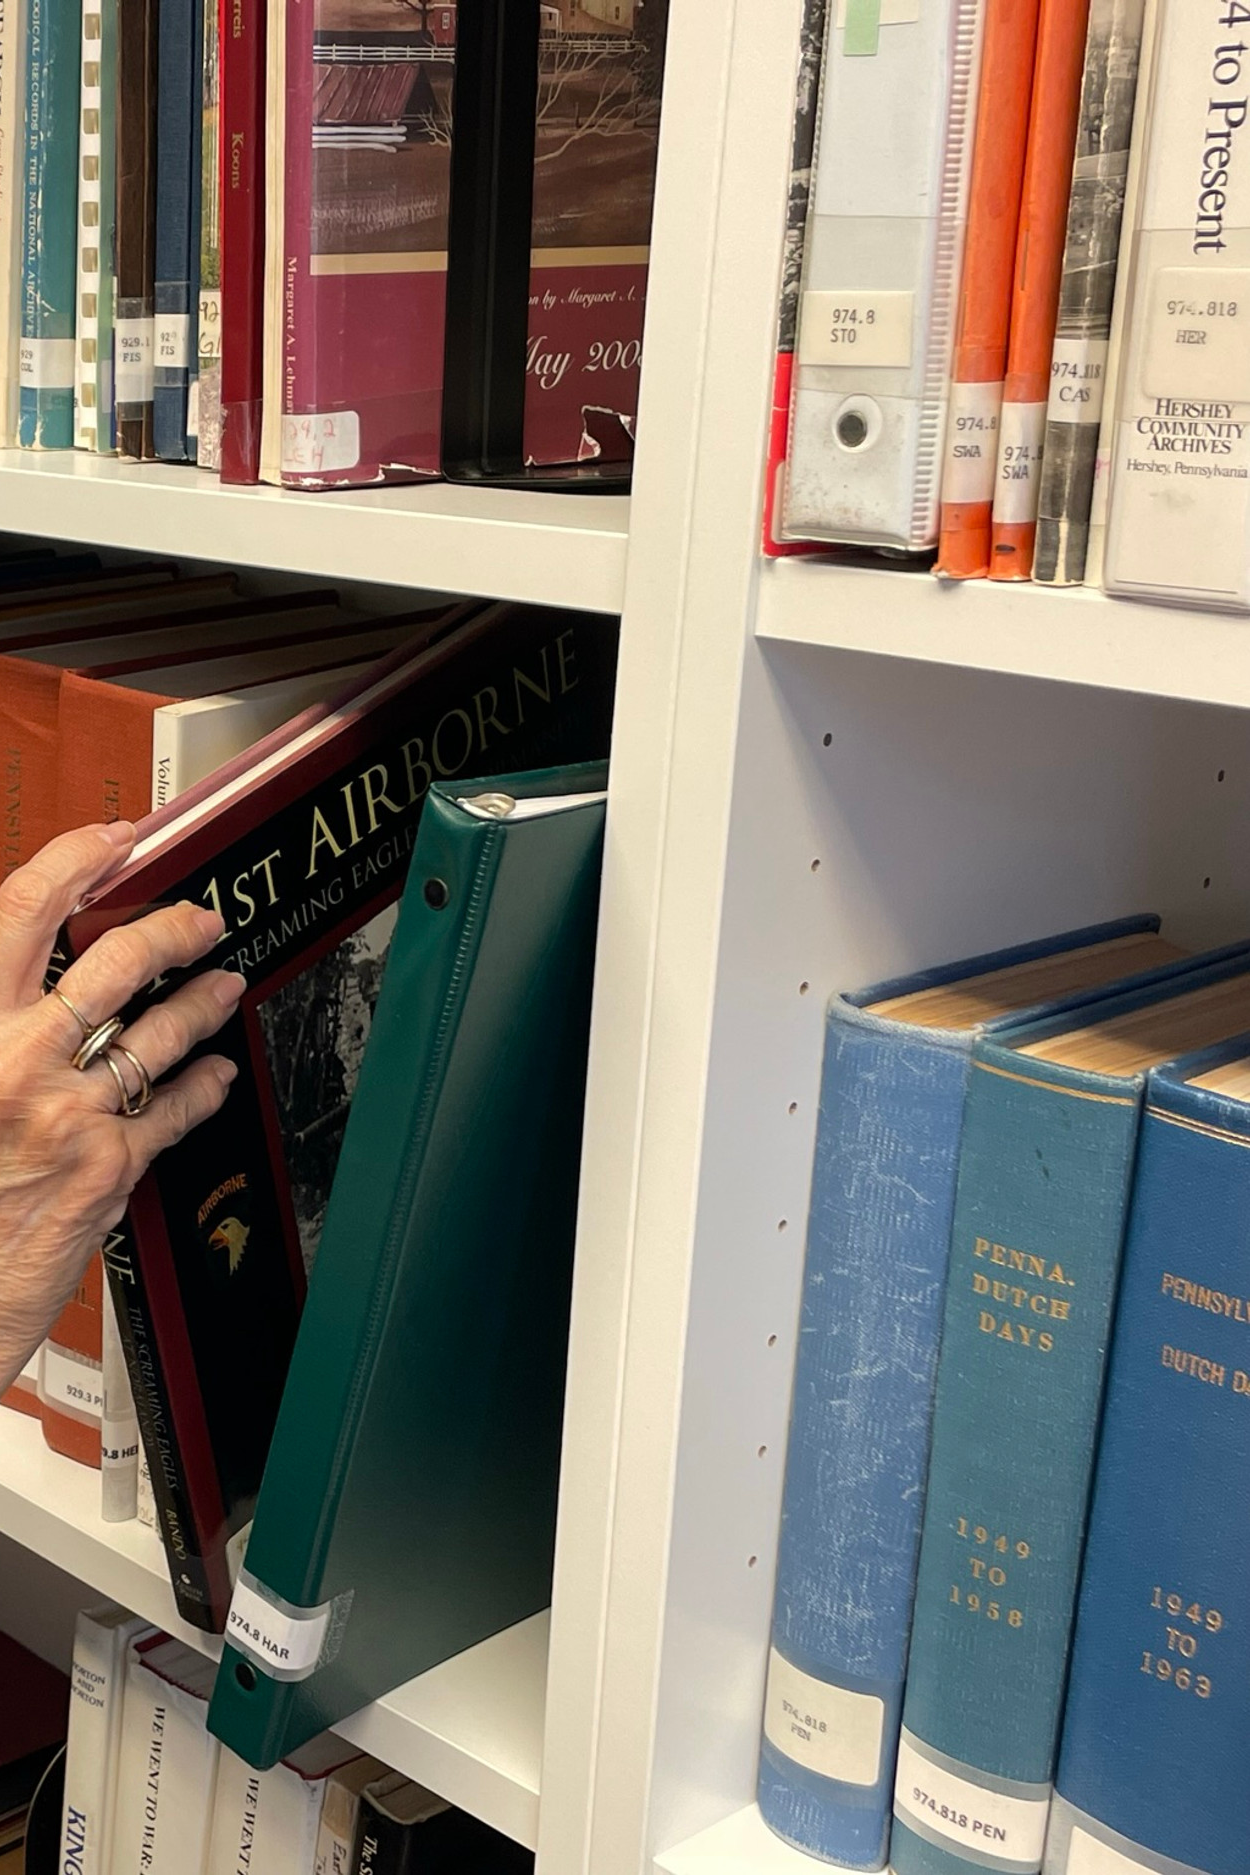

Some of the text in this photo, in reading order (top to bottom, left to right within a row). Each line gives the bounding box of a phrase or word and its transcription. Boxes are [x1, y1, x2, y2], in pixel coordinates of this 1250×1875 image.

[1211, 40, 1249, 86] to
[30, 61, 40, 131] RECORDS
[29, 136, 38, 150] IN
[29, 157, 38, 186] THE
[231, 131, 244, 190] Koons
[1193, 96, 1249, 255] Present
[27, 192, 38, 265] NATIONAL
[286, 256, 298, 330] Margaret
[542, 289, 557, 310] by
[561, 287, 616, 308] Margaret
[832, 309, 876, 325] 974.8
[160, 346, 175, 356] FIS
[830, 328, 857, 344] STO
[1175, 329, 1208, 345] HER
[122, 353, 142, 363] FIS
[1051, 361, 1102, 380] 974.818
[1058, 386, 1091, 402] CAS
[1154, 398, 1234, 419] HERSHEY
[955, 415, 997, 431] 974.8
[1136, 416, 1247, 439] COMMUNITY
[952, 445, 982, 458] SWA
[1147, 434, 1233, 455] ARCHIVES
[1001, 464, 1030, 480] SWA
[1126, 458, 1249, 479] Hershey, Pennsylvania
[305, 628, 581, 880] AIRBORNE
[220, 877, 345, 976] CREAMING
[196, 1172, 249, 1228] AIRBORNE
[973, 1236, 1076, 1287] PENNA.
[972, 1272, 1070, 1321] DUTCH
[978, 1311, 1055, 1352] DAYS
[1161, 1344, 1225, 1387] DUTCH
[66, 1384, 93, 1404] 929.3
[128, 1306, 187, 1561] THE SCREAMING EAGLES BANDO
[956, 1516, 1031, 1560] 1949
[969, 1557, 1007, 1587] TO
[949, 1584, 1024, 1629] 1958
[1150, 1586, 1223, 1633] 1949
[230, 1610, 290, 1660] 974.8 HAR
[1165, 1625, 1198, 1659] TO
[76, 1677, 95, 1693] AND
[1140, 1651, 1211, 1699] 1963
[781, 1700, 828, 1734] 974.818
[790, 1723, 812, 1742] PEN
[139, 1705, 166, 1870] WE WENT TO WAR:
[238, 1777, 260, 1868] WE WENT
[912, 1787, 1007, 1842] 974.818 PEN
[361, 1834, 378, 1864] The
